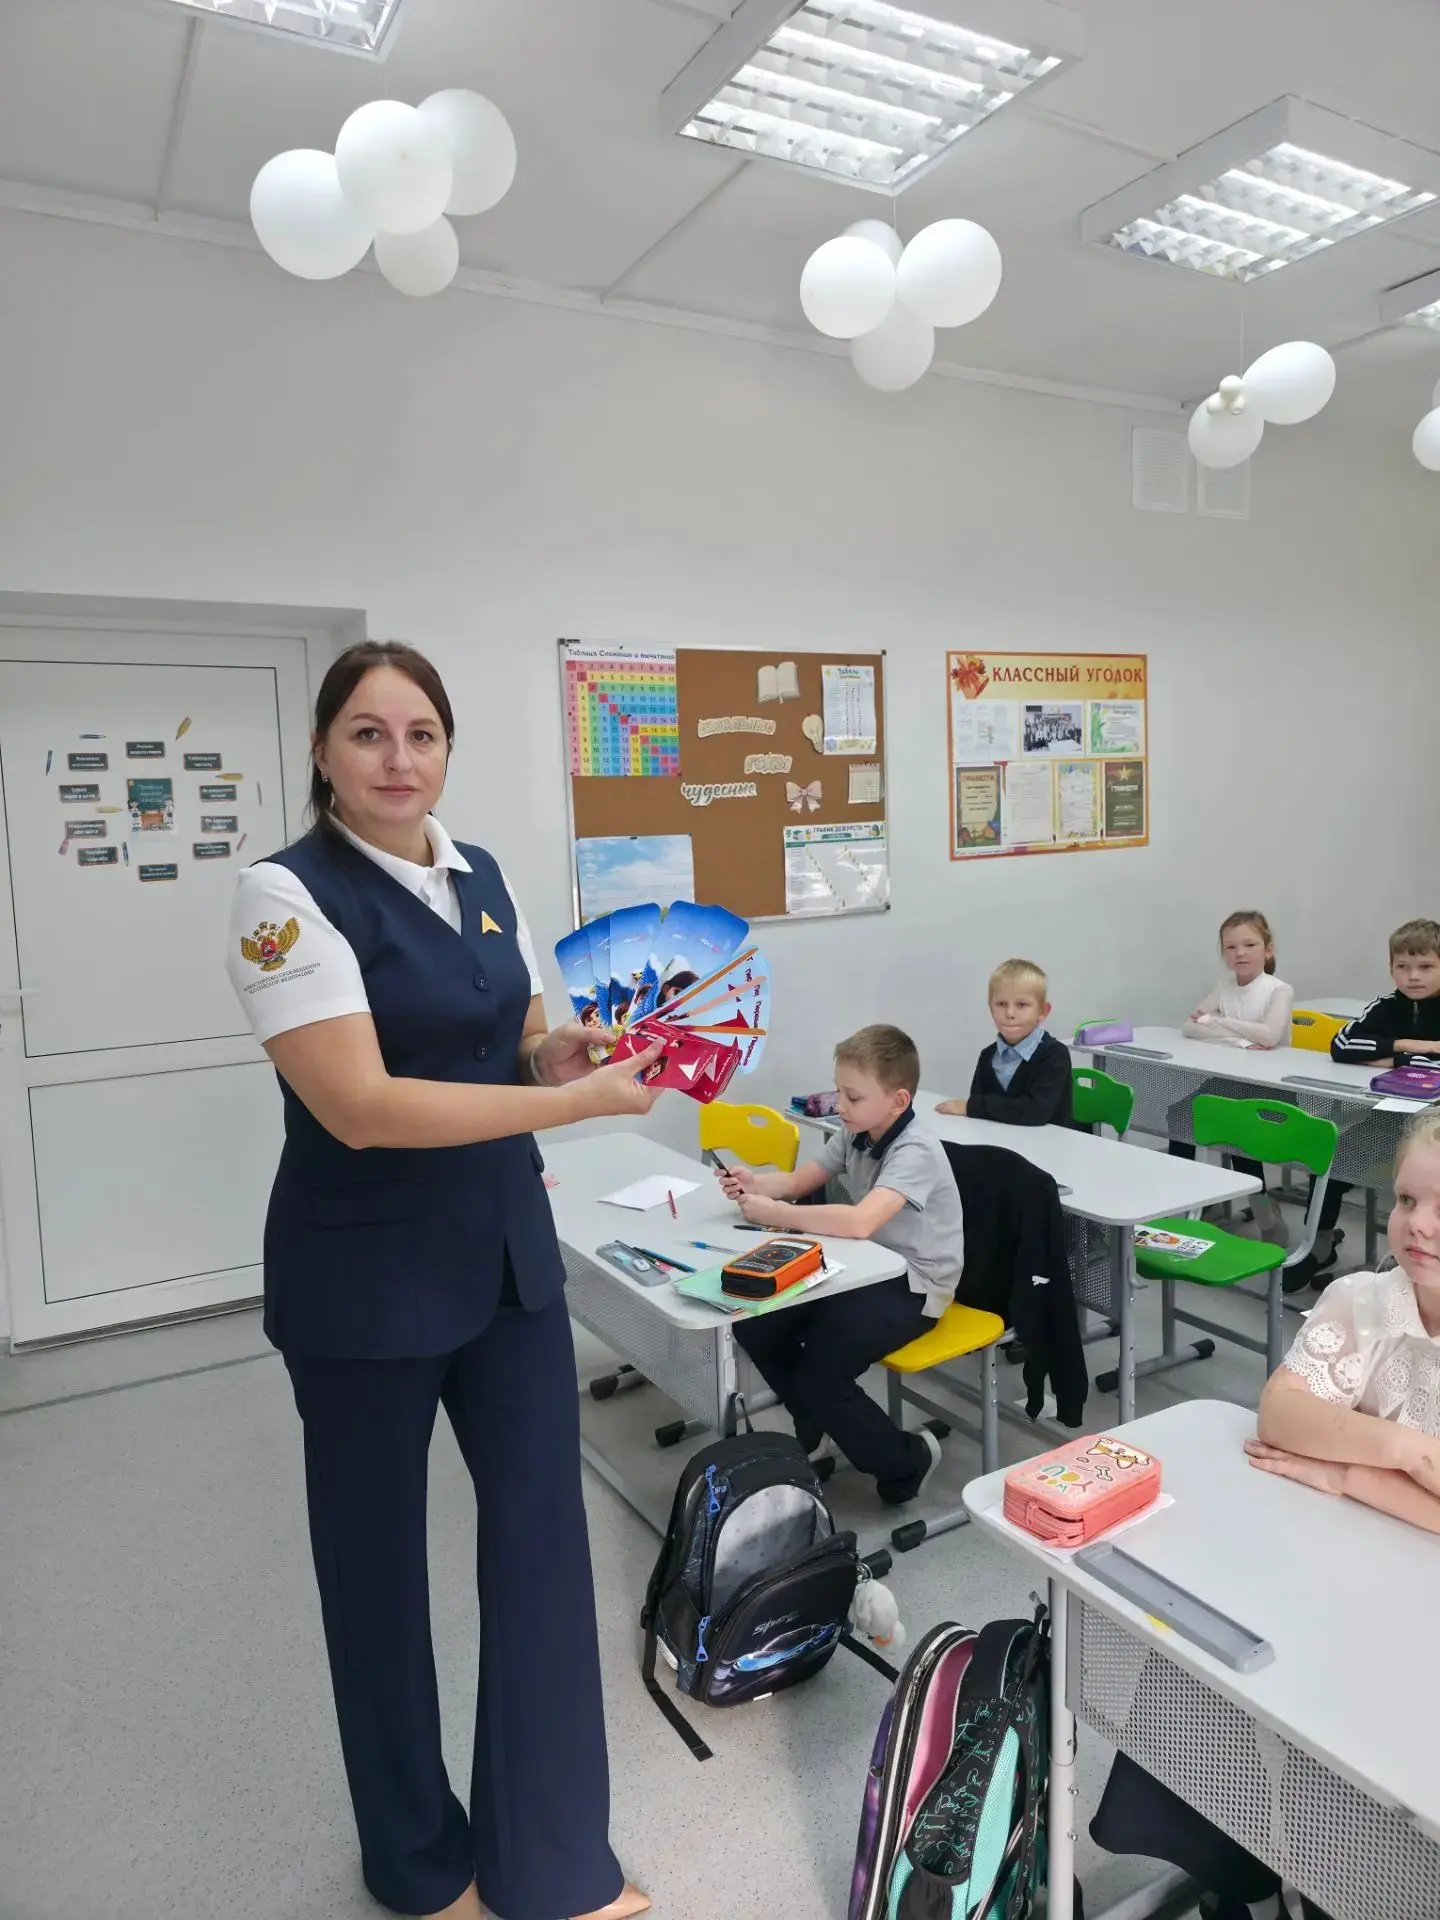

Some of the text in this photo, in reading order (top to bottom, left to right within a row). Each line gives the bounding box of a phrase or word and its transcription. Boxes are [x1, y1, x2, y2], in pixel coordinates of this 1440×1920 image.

[992, 665, 1143, 683] КЛАССНЫЙ УГОЛОК
[682, 783, 755, 803] чудесные
[743, 1036, 759, 1067] Первые
